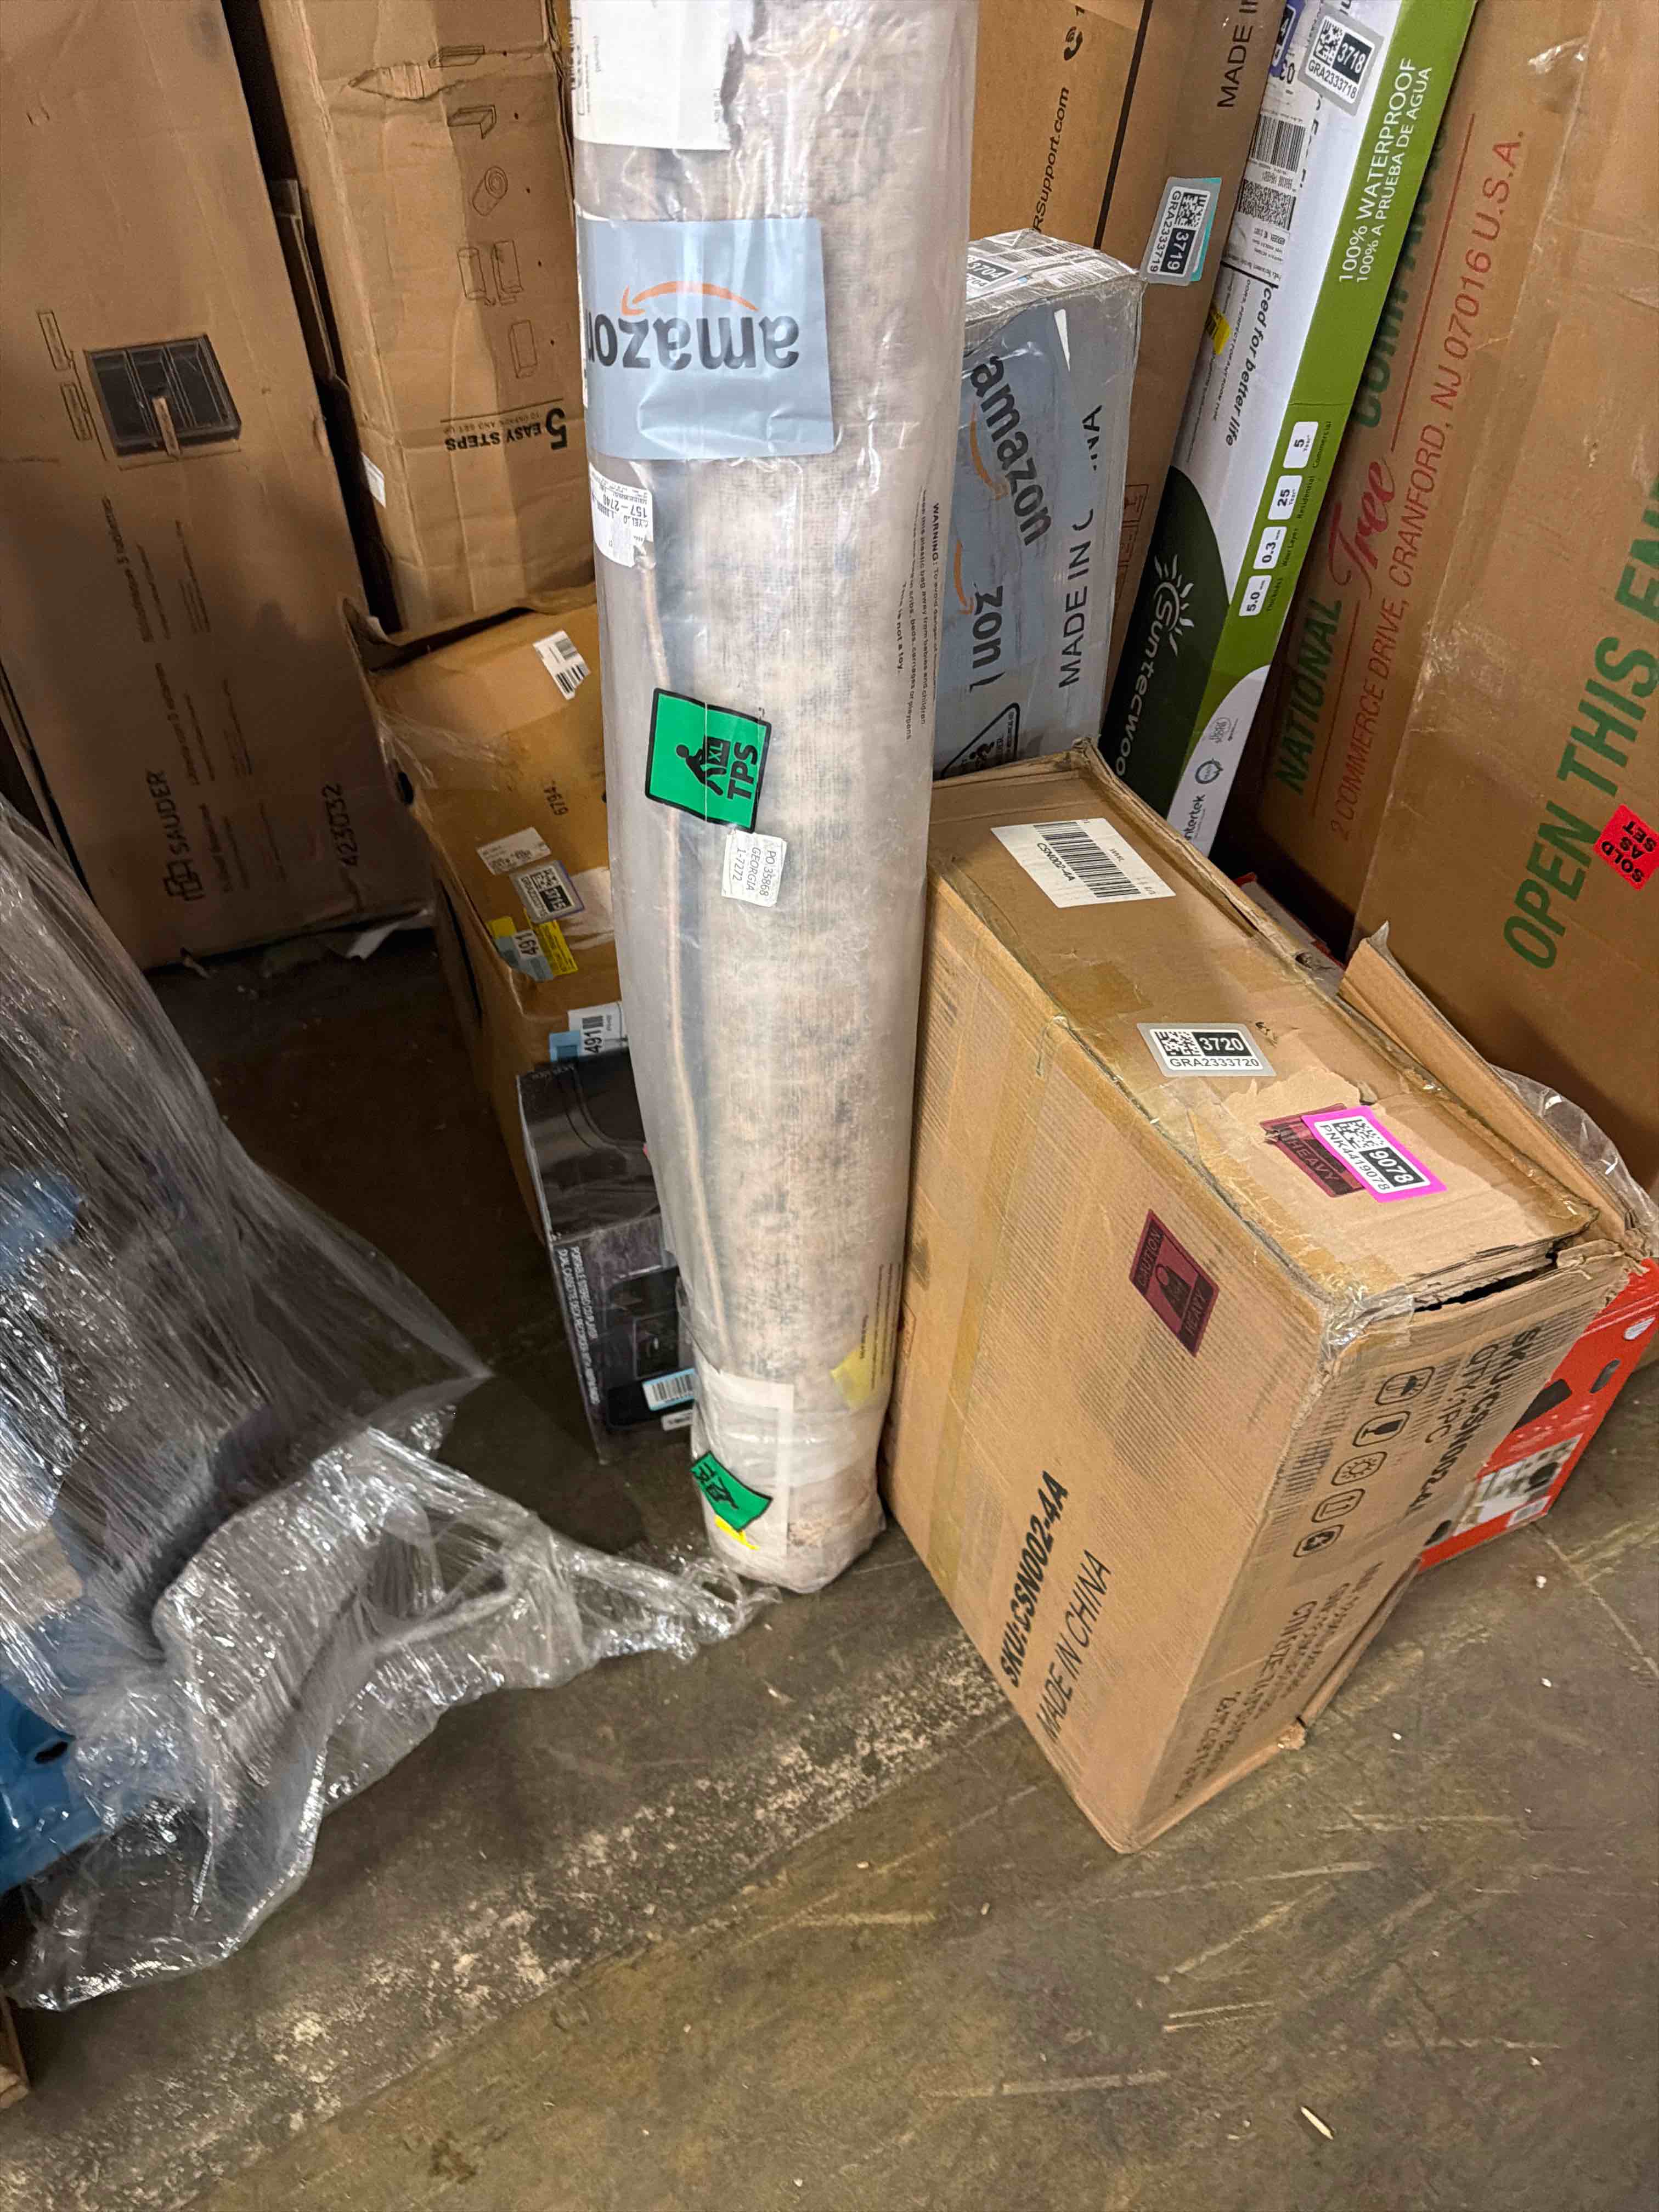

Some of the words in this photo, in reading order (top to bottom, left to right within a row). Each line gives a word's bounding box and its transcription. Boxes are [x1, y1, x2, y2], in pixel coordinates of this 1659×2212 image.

[1217, 25, 1253, 108] MADE
[1308, 59, 1357, 99] GRA2333718
[1337, 43, 1366, 74] 3718
[1406, 66, 1432, 120] AGUA
[1396, 125, 1414, 148] DE
[1339, 225, 1368, 283] 100%
[1356, 58, 1416, 219] WATERPROOF
[1375, 152, 1405, 219] PRUEBA
[1472, 130, 1524, 240] U.S.A.
[1150, 190, 1181, 272] GRA2333719
[1167, 232, 1189, 270] 3719
[1372, 224, 1385, 236] A
[972, 261, 1005, 279] 3704
[1357, 239, 1379, 283] 100%
[1257, 285, 1274, 328] ced
[1444, 249, 1492, 358] 07016
[585, 309, 800, 370] amazon
[1249, 327, 1263, 358] for
[1234, 358, 1256, 416] better
[1430, 365, 1463, 408] NJ
[444, 432, 501, 452] STEPS
[506, 422, 541, 443] EASY
[546, 408, 567, 450] 5
[970, 354, 1052, 546] amazon
[1225, 415, 1241, 446] life
[1294, 439, 1304, 448] 5
[1277, 489, 1290, 507] 25
[1389, 422, 1455, 585] CRANFORD,
[1069, 539, 1092, 579] IN
[1262, 541, 1276, 563] 0.3
[1246, 592, 1260, 612] 5.0
[1059, 585, 1087, 689] MADE
[1271, 599, 1342, 795] NATIONAL
[1329, 459, 1396, 599] Tree
[1370, 594, 1408, 678] DRIVE,
[708, 741, 724, 763] XL
[727, 742, 758, 800] TPS
[1335, 680, 1386, 836] COMMERCE
[146, 770, 190, 855] SAUDER
[1184, 794, 1206, 841] ntertek
[1504, 800, 1601, 969] OPEN
[1556, 636, 1659, 797] THIS
[322, 783, 359, 867] 423032
[1330, 818, 1351, 842] 2
[1623, 820, 1657, 852] SET
[732, 847, 747, 882] 1-7272
[746, 847, 761, 891] GEORGIA
[765, 850, 776, 865] PO
[1036, 842, 1076, 882] CSN002-4A
[1601, 840, 1643, 885] SOLD
[1620, 835, 1644, 860] AS
[759, 867, 774, 896] 35868
[515, 930, 539, 956] 491
[583, 1030, 602, 1054] 491
[1170, 1057, 1260, 1068] GRA2333720
[1199, 1037, 1244, 1052] 3720
[1290, 1139, 1339, 1181] HEAVY
[1320, 1124, 1391, 1190] PNK4419078
[1369, 1149, 1415, 1184] 9078
[1139, 1226, 1164, 1287] CAUTION
[1184, 1286, 1203, 1335] HEAVY
[999, 1470, 1069, 1688] SKU:CSN002-4A
[1068, 1549, 1113, 1649] CHINA
[1057, 1633, 1082, 1681] IN
[1036, 1662, 1073, 1746] MADE
